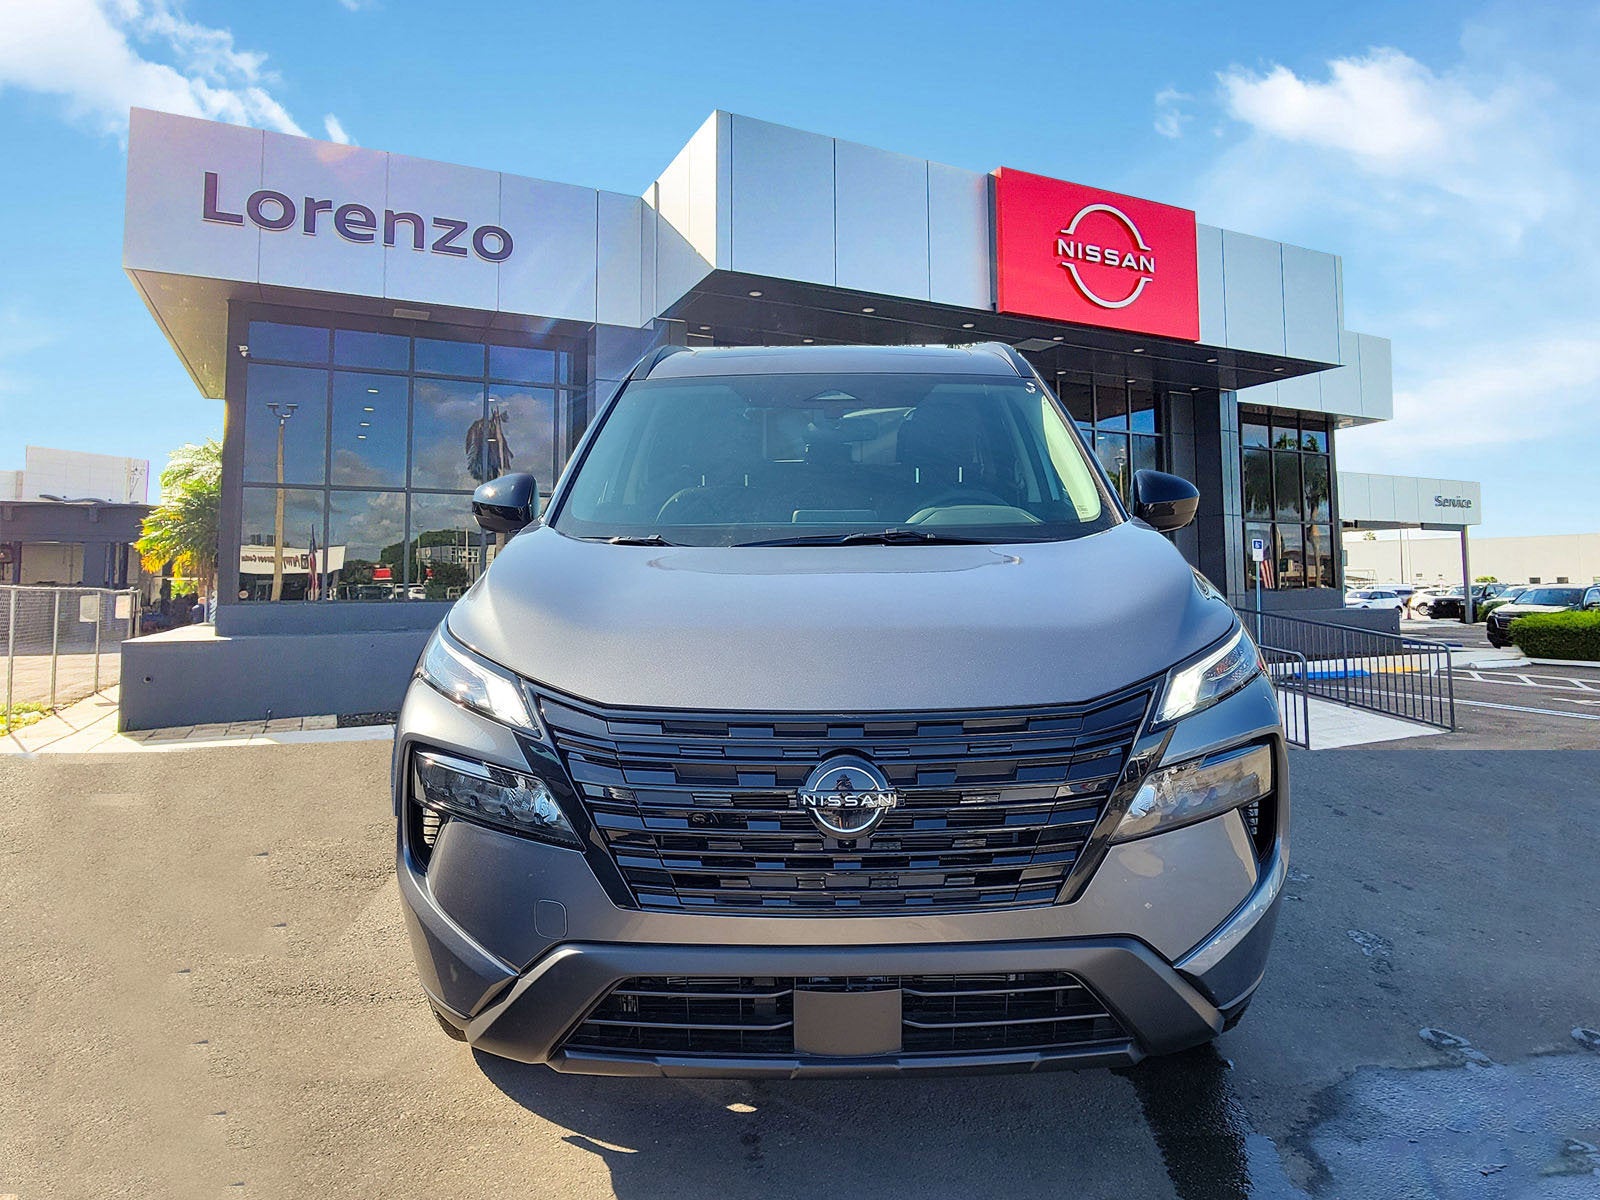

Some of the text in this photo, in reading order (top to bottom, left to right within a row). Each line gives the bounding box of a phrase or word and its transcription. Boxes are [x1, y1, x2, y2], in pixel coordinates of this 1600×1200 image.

[203, 171, 514, 262] Lorenzo
[1057, 238, 1155, 273] NISSAN
[1434, 495, 1472, 509] Service
[802, 794, 892, 807] NISSAN
